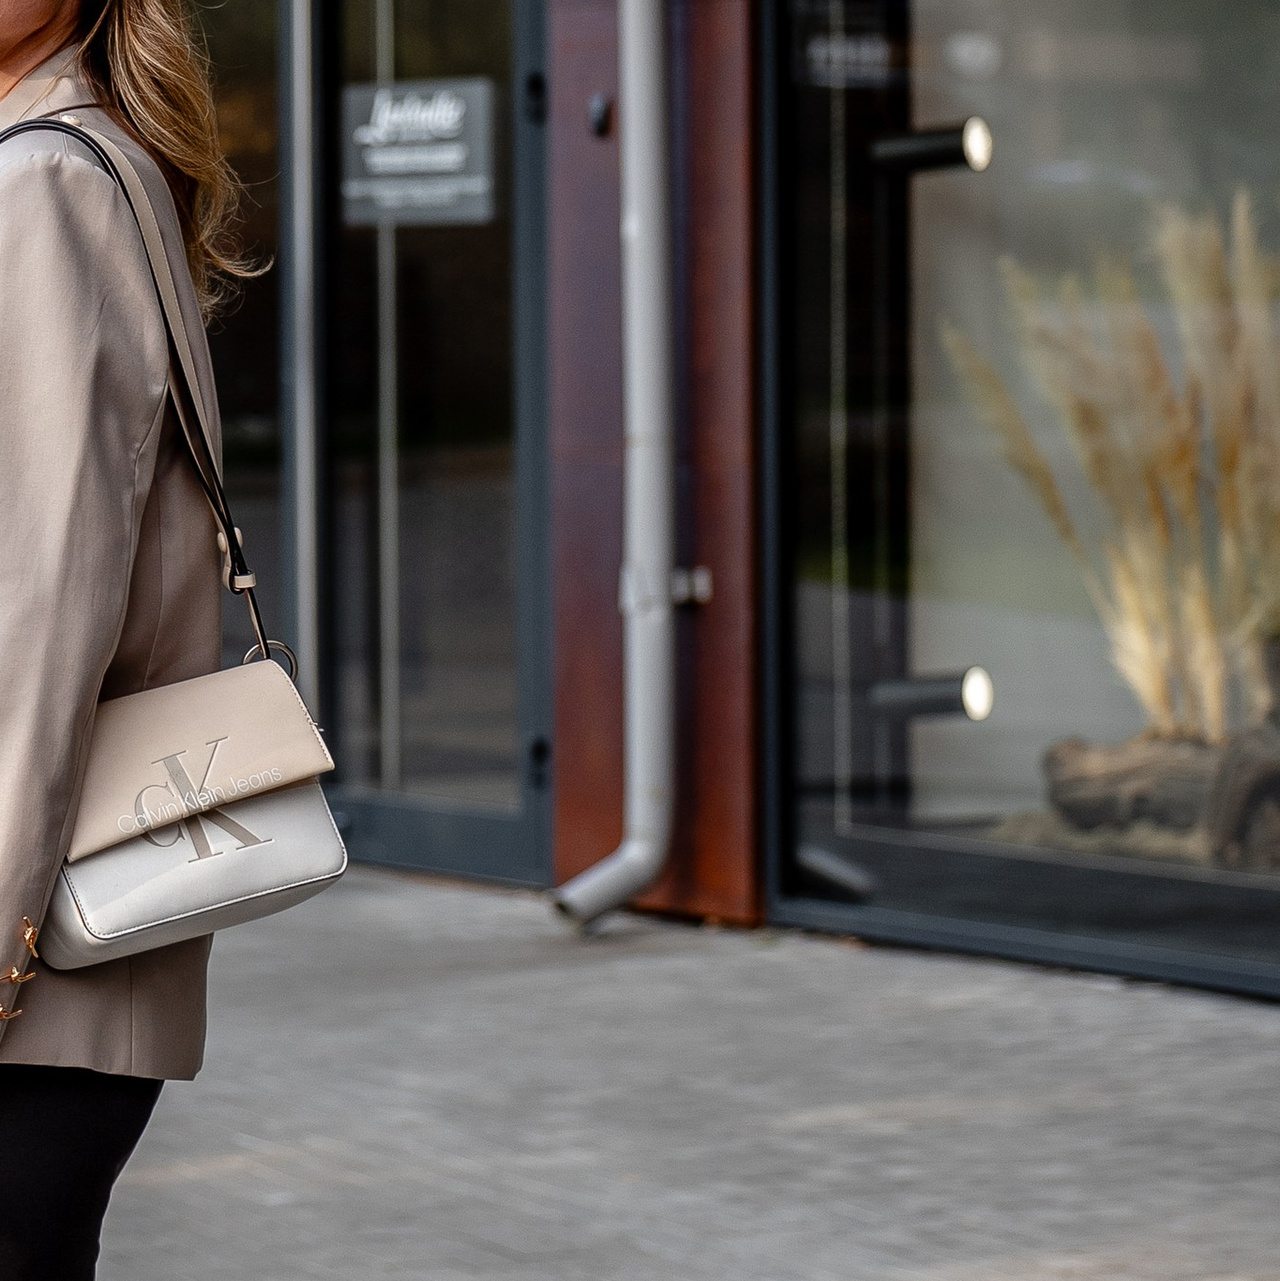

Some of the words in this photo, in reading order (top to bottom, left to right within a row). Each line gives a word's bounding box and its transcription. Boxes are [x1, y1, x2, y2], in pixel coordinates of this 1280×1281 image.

[117, 799, 179, 834] Calvin
[176, 783, 226, 815] Klein
[228, 766, 283, 797] Jeans
